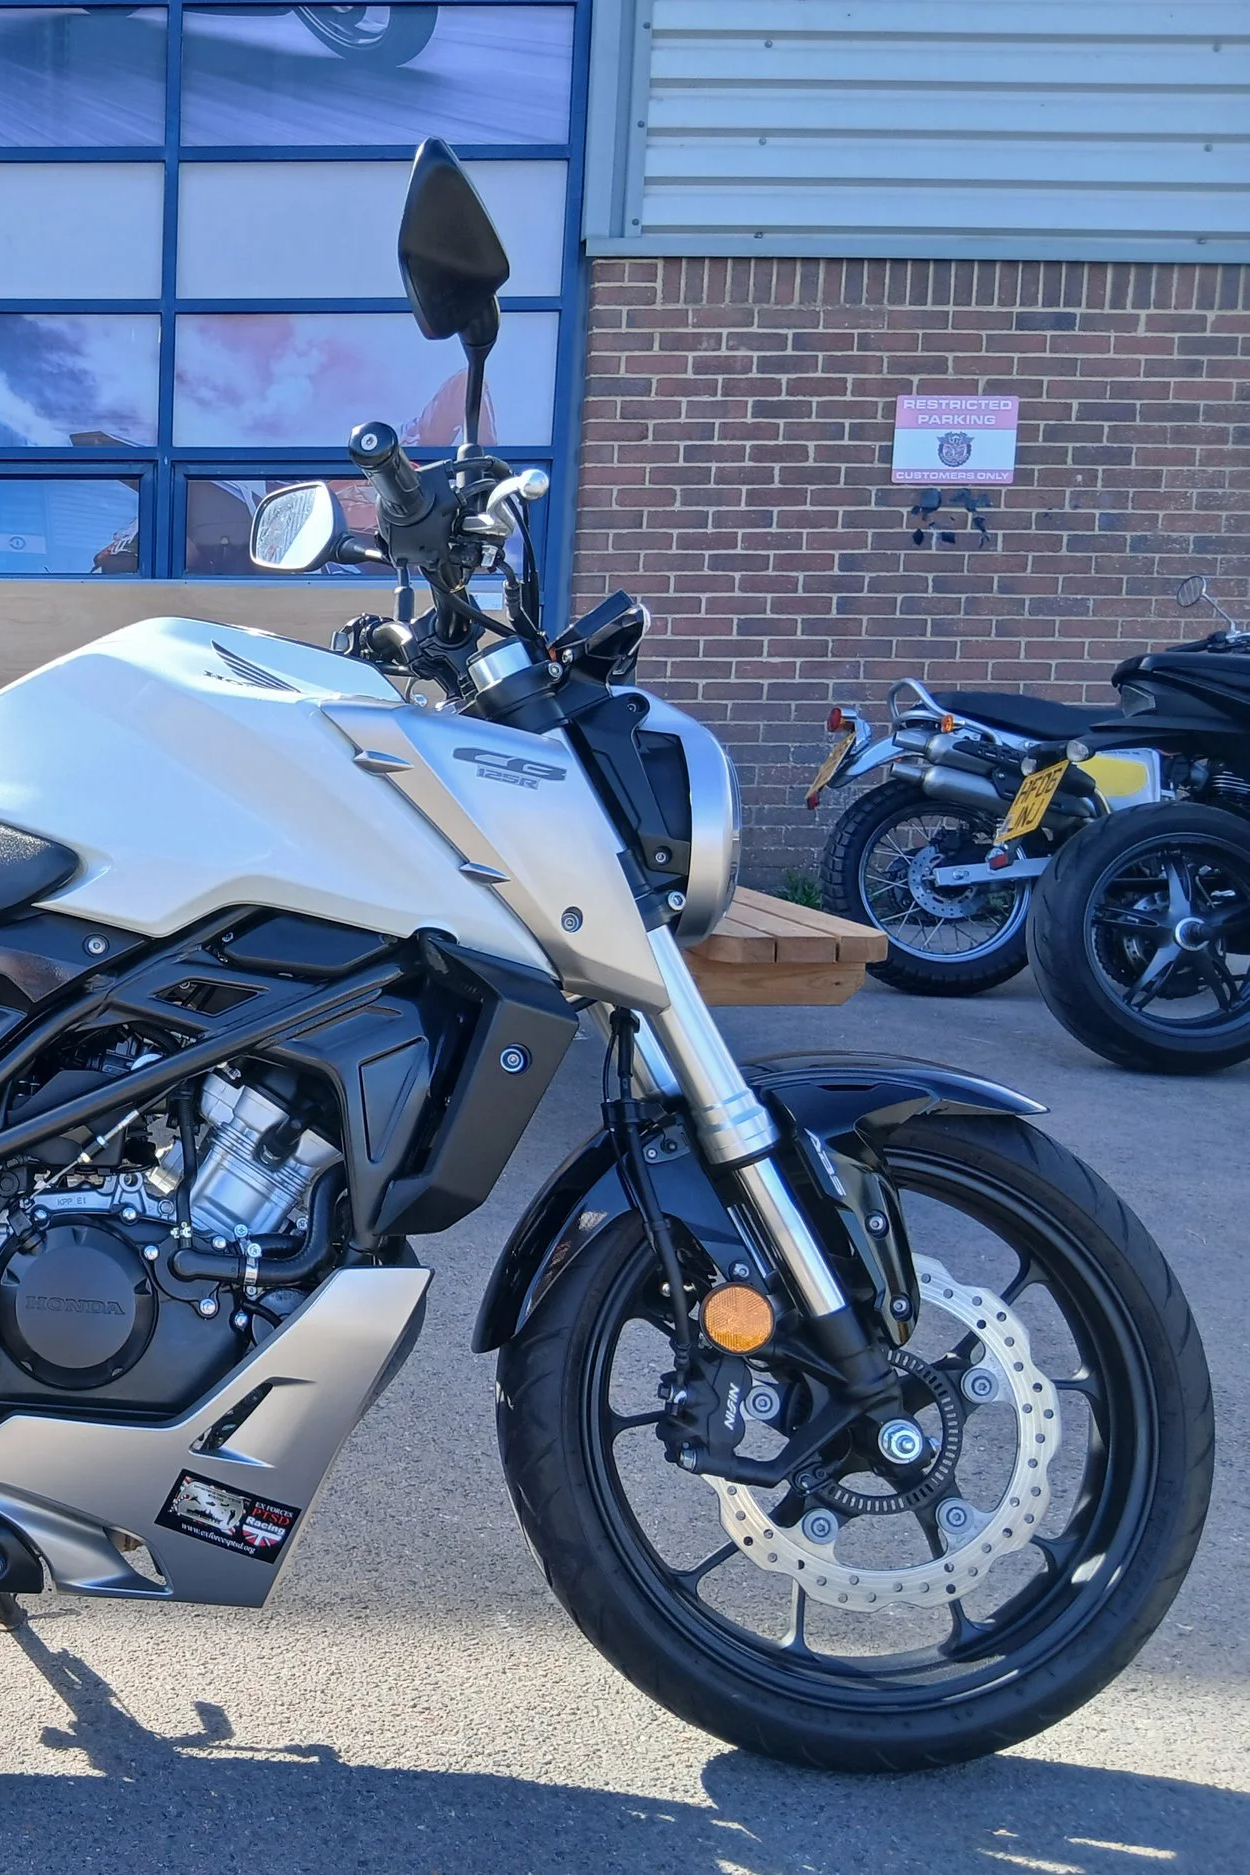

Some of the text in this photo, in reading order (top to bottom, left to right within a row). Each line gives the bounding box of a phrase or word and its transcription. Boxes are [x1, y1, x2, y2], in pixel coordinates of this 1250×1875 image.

[903, 400, 1012, 410] RESTRICTED
[917, 414, 996, 425] PARKING
[896, 471, 1009, 480] CUSTOMERS ONLY
[452, 747, 567, 781] CB
[477, 768, 538, 790] 125R
[25, 1295, 126, 1315] HONDA
[245, 1515, 286, 1536] Racing
[251, 1507, 291, 1526] PTSD
